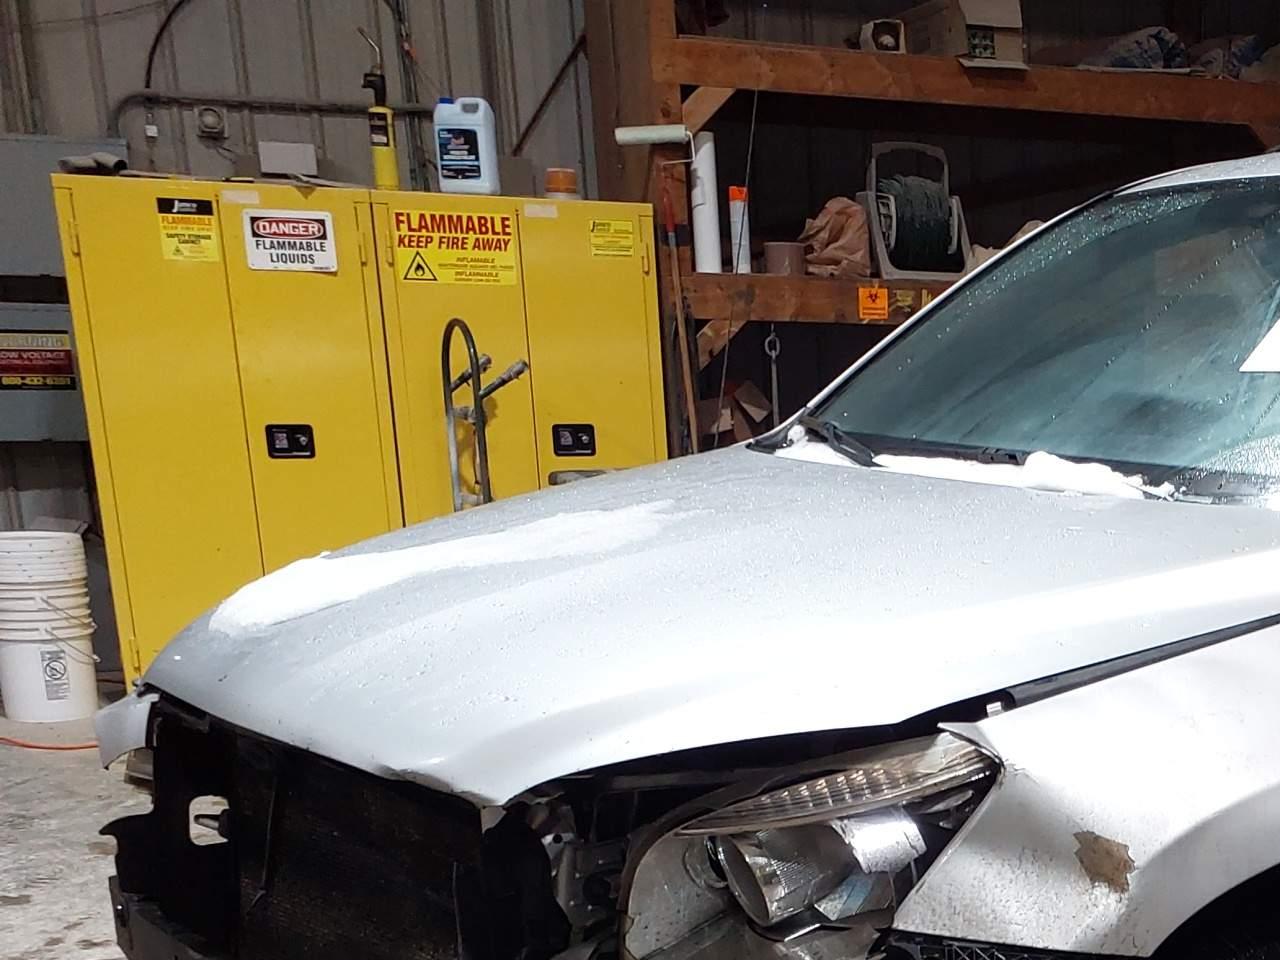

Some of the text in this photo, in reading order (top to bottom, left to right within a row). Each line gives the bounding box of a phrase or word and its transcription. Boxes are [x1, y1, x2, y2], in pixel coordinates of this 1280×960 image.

[258, 221, 319, 236] DANGER
[394, 211, 512, 237] FLAMMABLE
[255, 239, 327, 253] FLAMMABLE
[397, 234, 511, 253] KEEP FIRE AWAY
[269, 252, 315, 265] LIQUIDS
